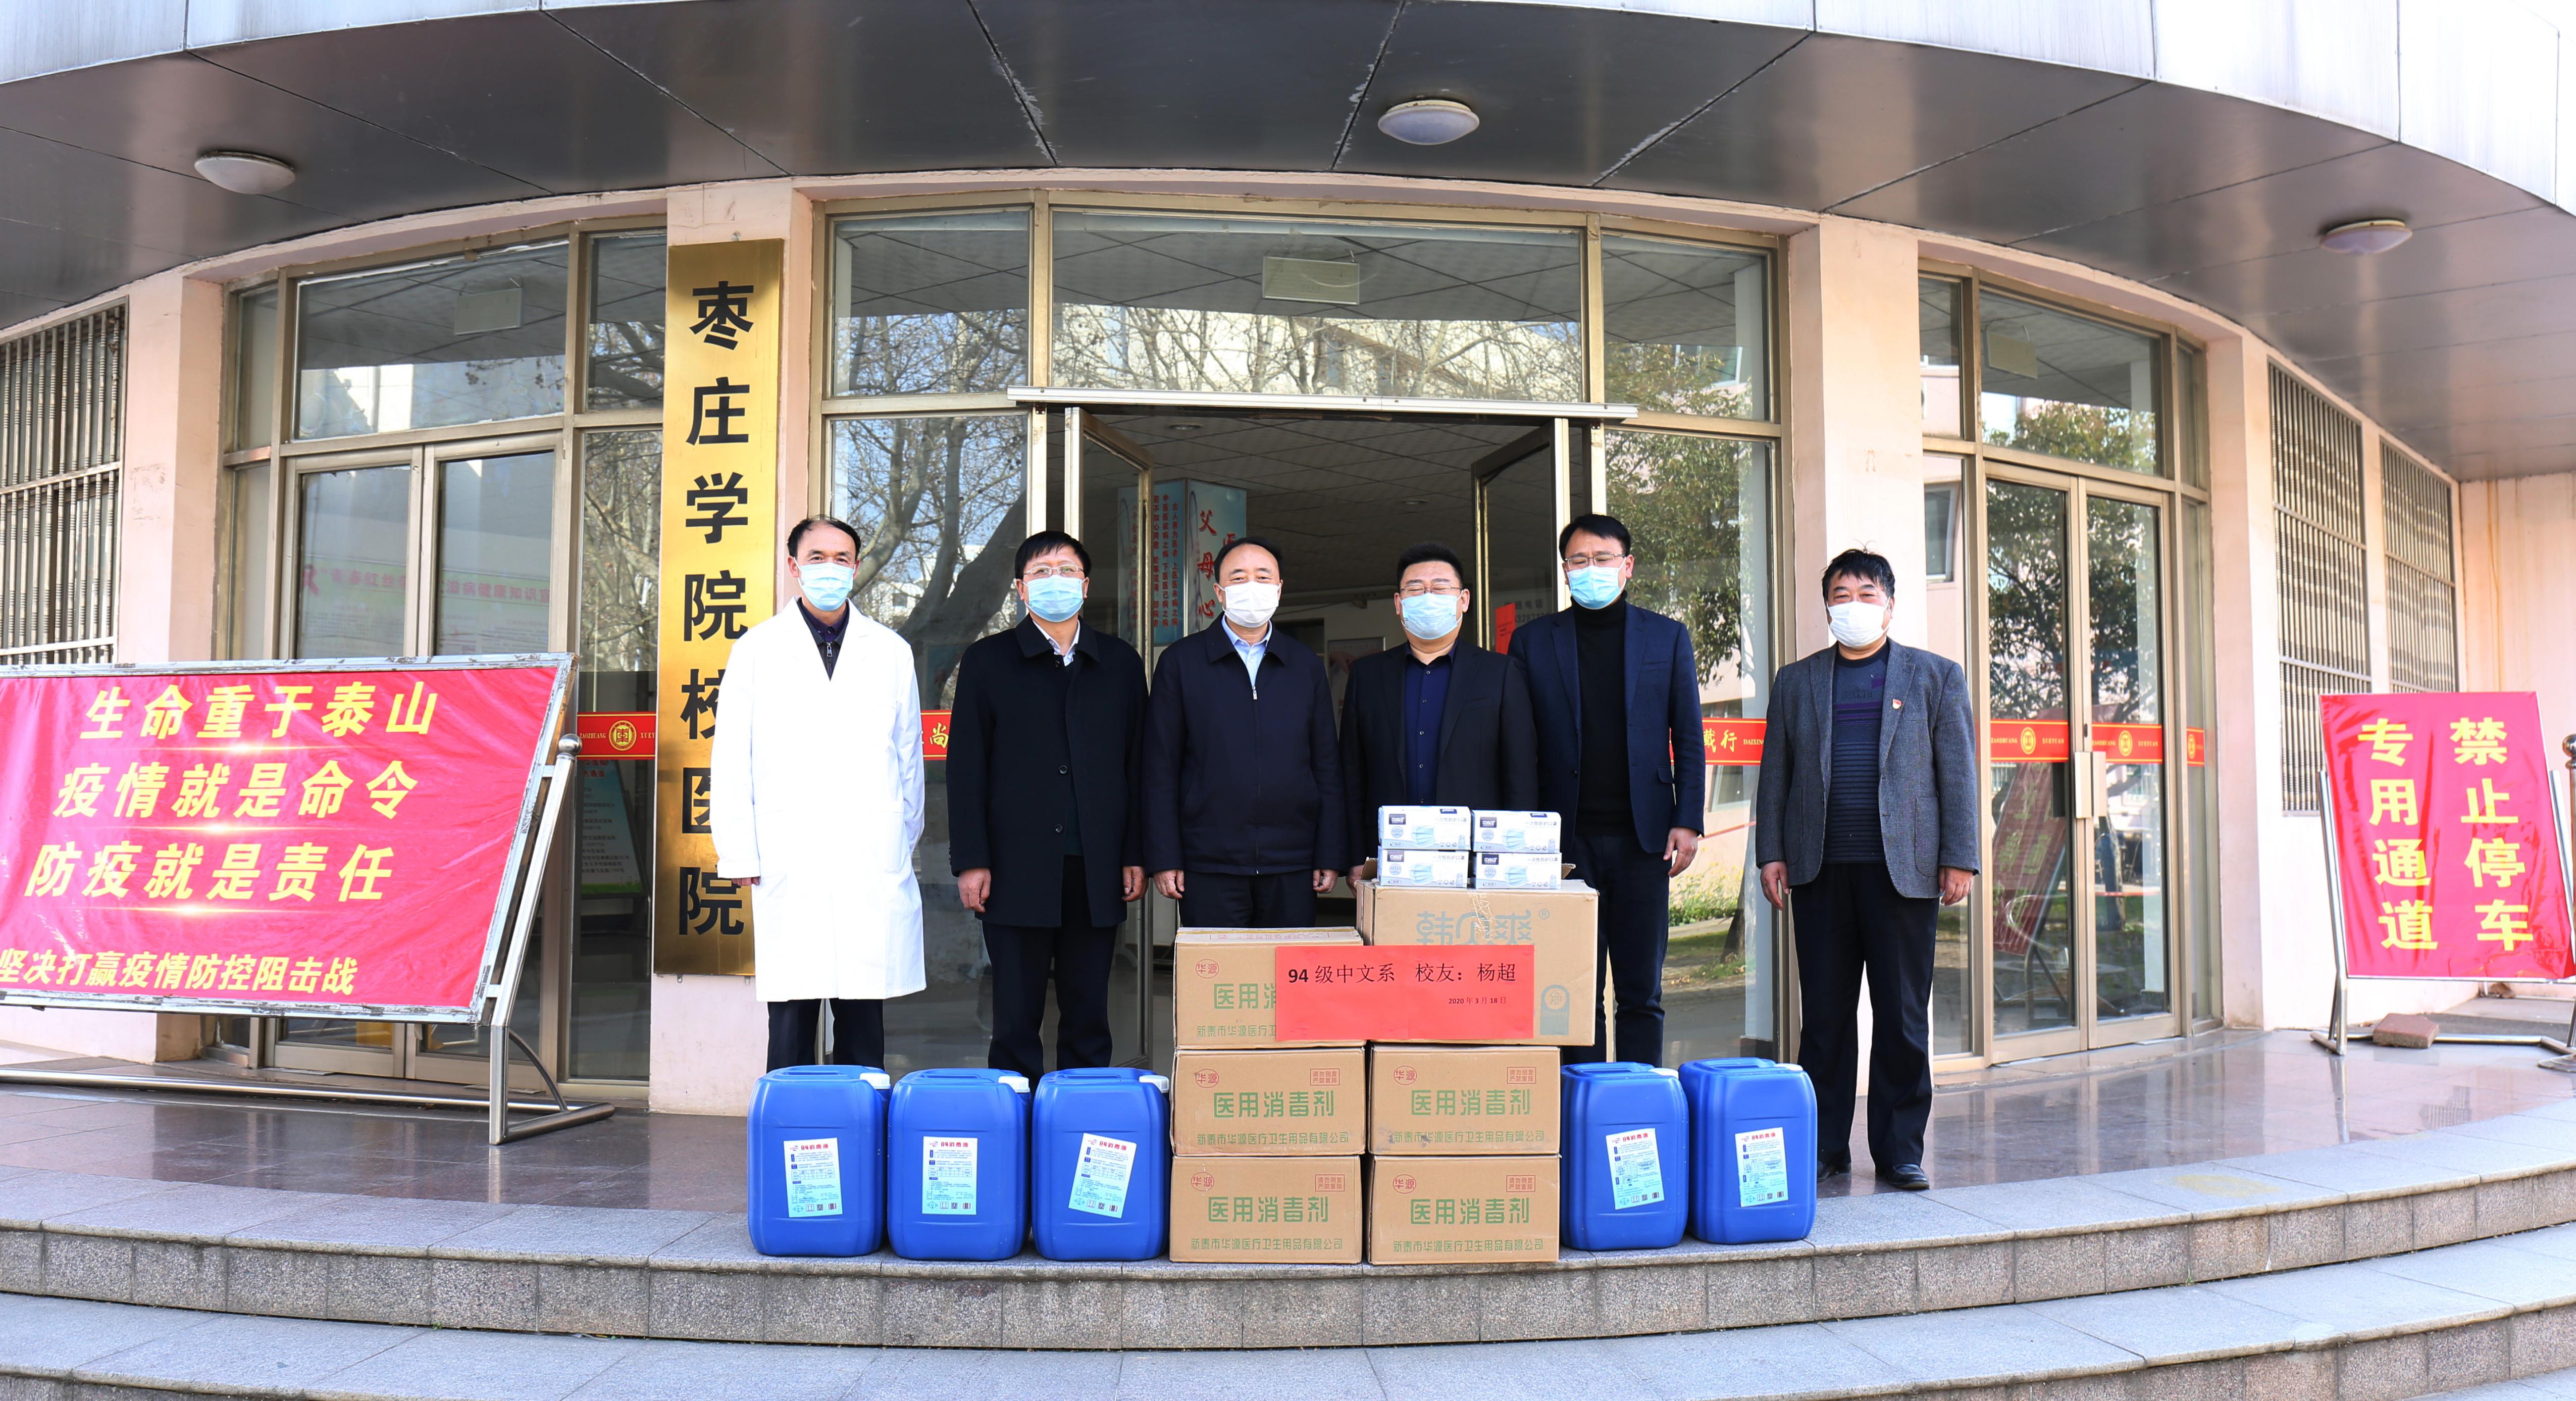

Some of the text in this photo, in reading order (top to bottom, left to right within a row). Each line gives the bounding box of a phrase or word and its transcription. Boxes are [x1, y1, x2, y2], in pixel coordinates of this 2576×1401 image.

[81, 681, 438, 739] 生命重于泰山
[930, 722, 949, 748] 尚
[53, 760, 418, 820] 疫情就是命令
[2357, 718, 2439, 950] 专用通道
[2450, 717, 2534, 952] 禁止停车
[24, 841, 395, 903] 防疫就是责任
[0, 948, 357, 995] 坚决打赢疫情防控阻击战
[1196, 962, 1219, 975] 华源
[1197, 1073, 1218, 1084] 华源
[1395, 1070, 1416, 1081] 华源
[1213, 1090, 1335, 1118] 医用消毒剂
[1410, 1088, 1531, 1116] 医用消毒剂
[1196, 1132, 1349, 1145] 新泰市华源医疗卫生用品有限公司
[1394, 1130, 1545, 1144] 新泰市华源医疗卫生用品有限公司
[1192, 1176, 1213, 1187] 华源
[1394, 1178, 1415, 1190] 华源
[1208, 1196, 1329, 1223] 医用消毒剂
[1410, 1197, 1530, 1225] 医用消毒剂
[1191, 1237, 1343, 1251] 新泰市华源医疗卫生用品有限公司
[1393, 1238, 1544, 1253] 新泰市华源医疗卫生用品有限公司
